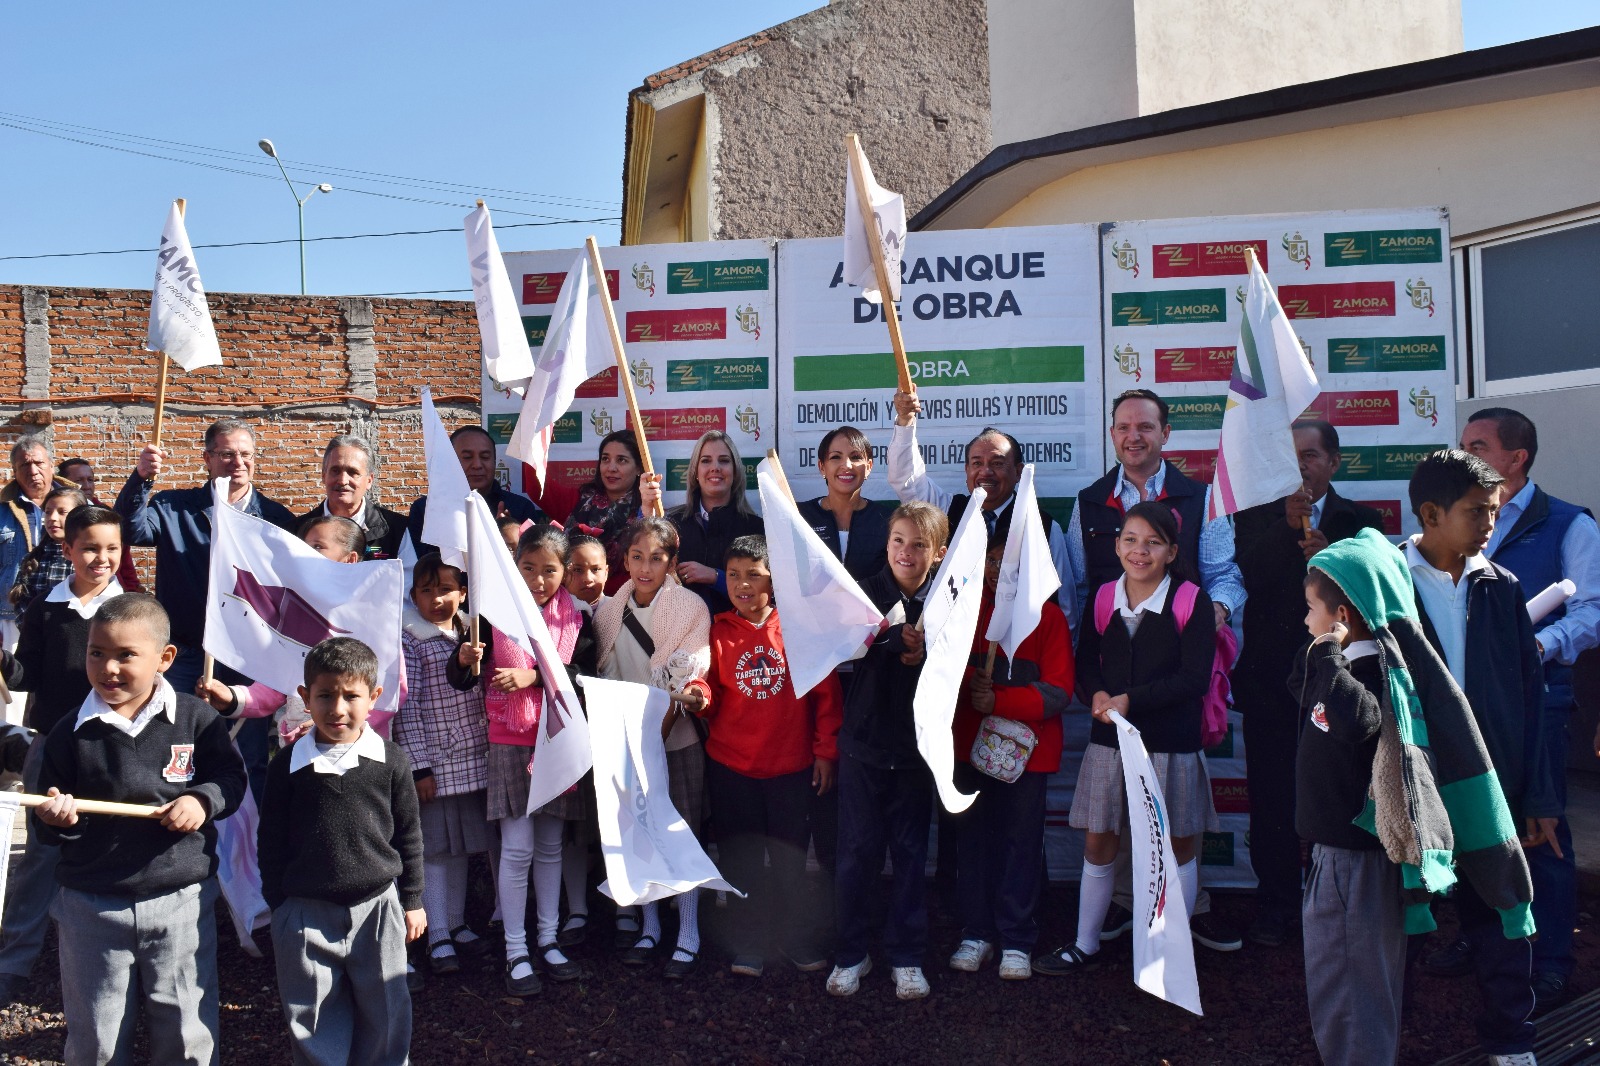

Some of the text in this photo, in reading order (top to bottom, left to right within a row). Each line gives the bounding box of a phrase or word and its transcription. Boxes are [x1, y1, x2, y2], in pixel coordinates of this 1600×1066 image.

[1379, 236, 1435, 247] ZAMORA
[714, 265, 763, 276] ZAMORA
[829, 251, 1046, 288] ARANQUE
[853, 289, 1022, 324] DE OBRA
[1333, 297, 1388, 309] ZAMORA
[1164, 304, 1219, 316] ZAMORA
[672, 322, 720, 333] ZAMORA
[1382, 343, 1438, 354] ZAMORA
[1208, 350, 1237, 360] ZAM
[713, 364, 763, 375] ZAMORA
[906, 359, 970, 379] OBRA
[797, 394, 1068, 424] DEMOLICIÓN Y EVAS AULAS Y PATIOS
[1168, 402, 1221, 414] ZAMORA
[1335, 398, 1391, 409] ZAMORA
[672, 414, 720, 425] ZAMORA
[800, 447, 816, 468] DE
[941, 439, 966, 465] LÁZ
[1018, 442, 1072, 464] RDENAS
[1385, 452, 1429, 463] ZAMO
[566, 467, 597, 477] ZAMO
[735, 667, 785, 680] VARSITY TEAM
[756, 690, 770, 700] ED.
[1214, 785, 1248, 796] ZAM
